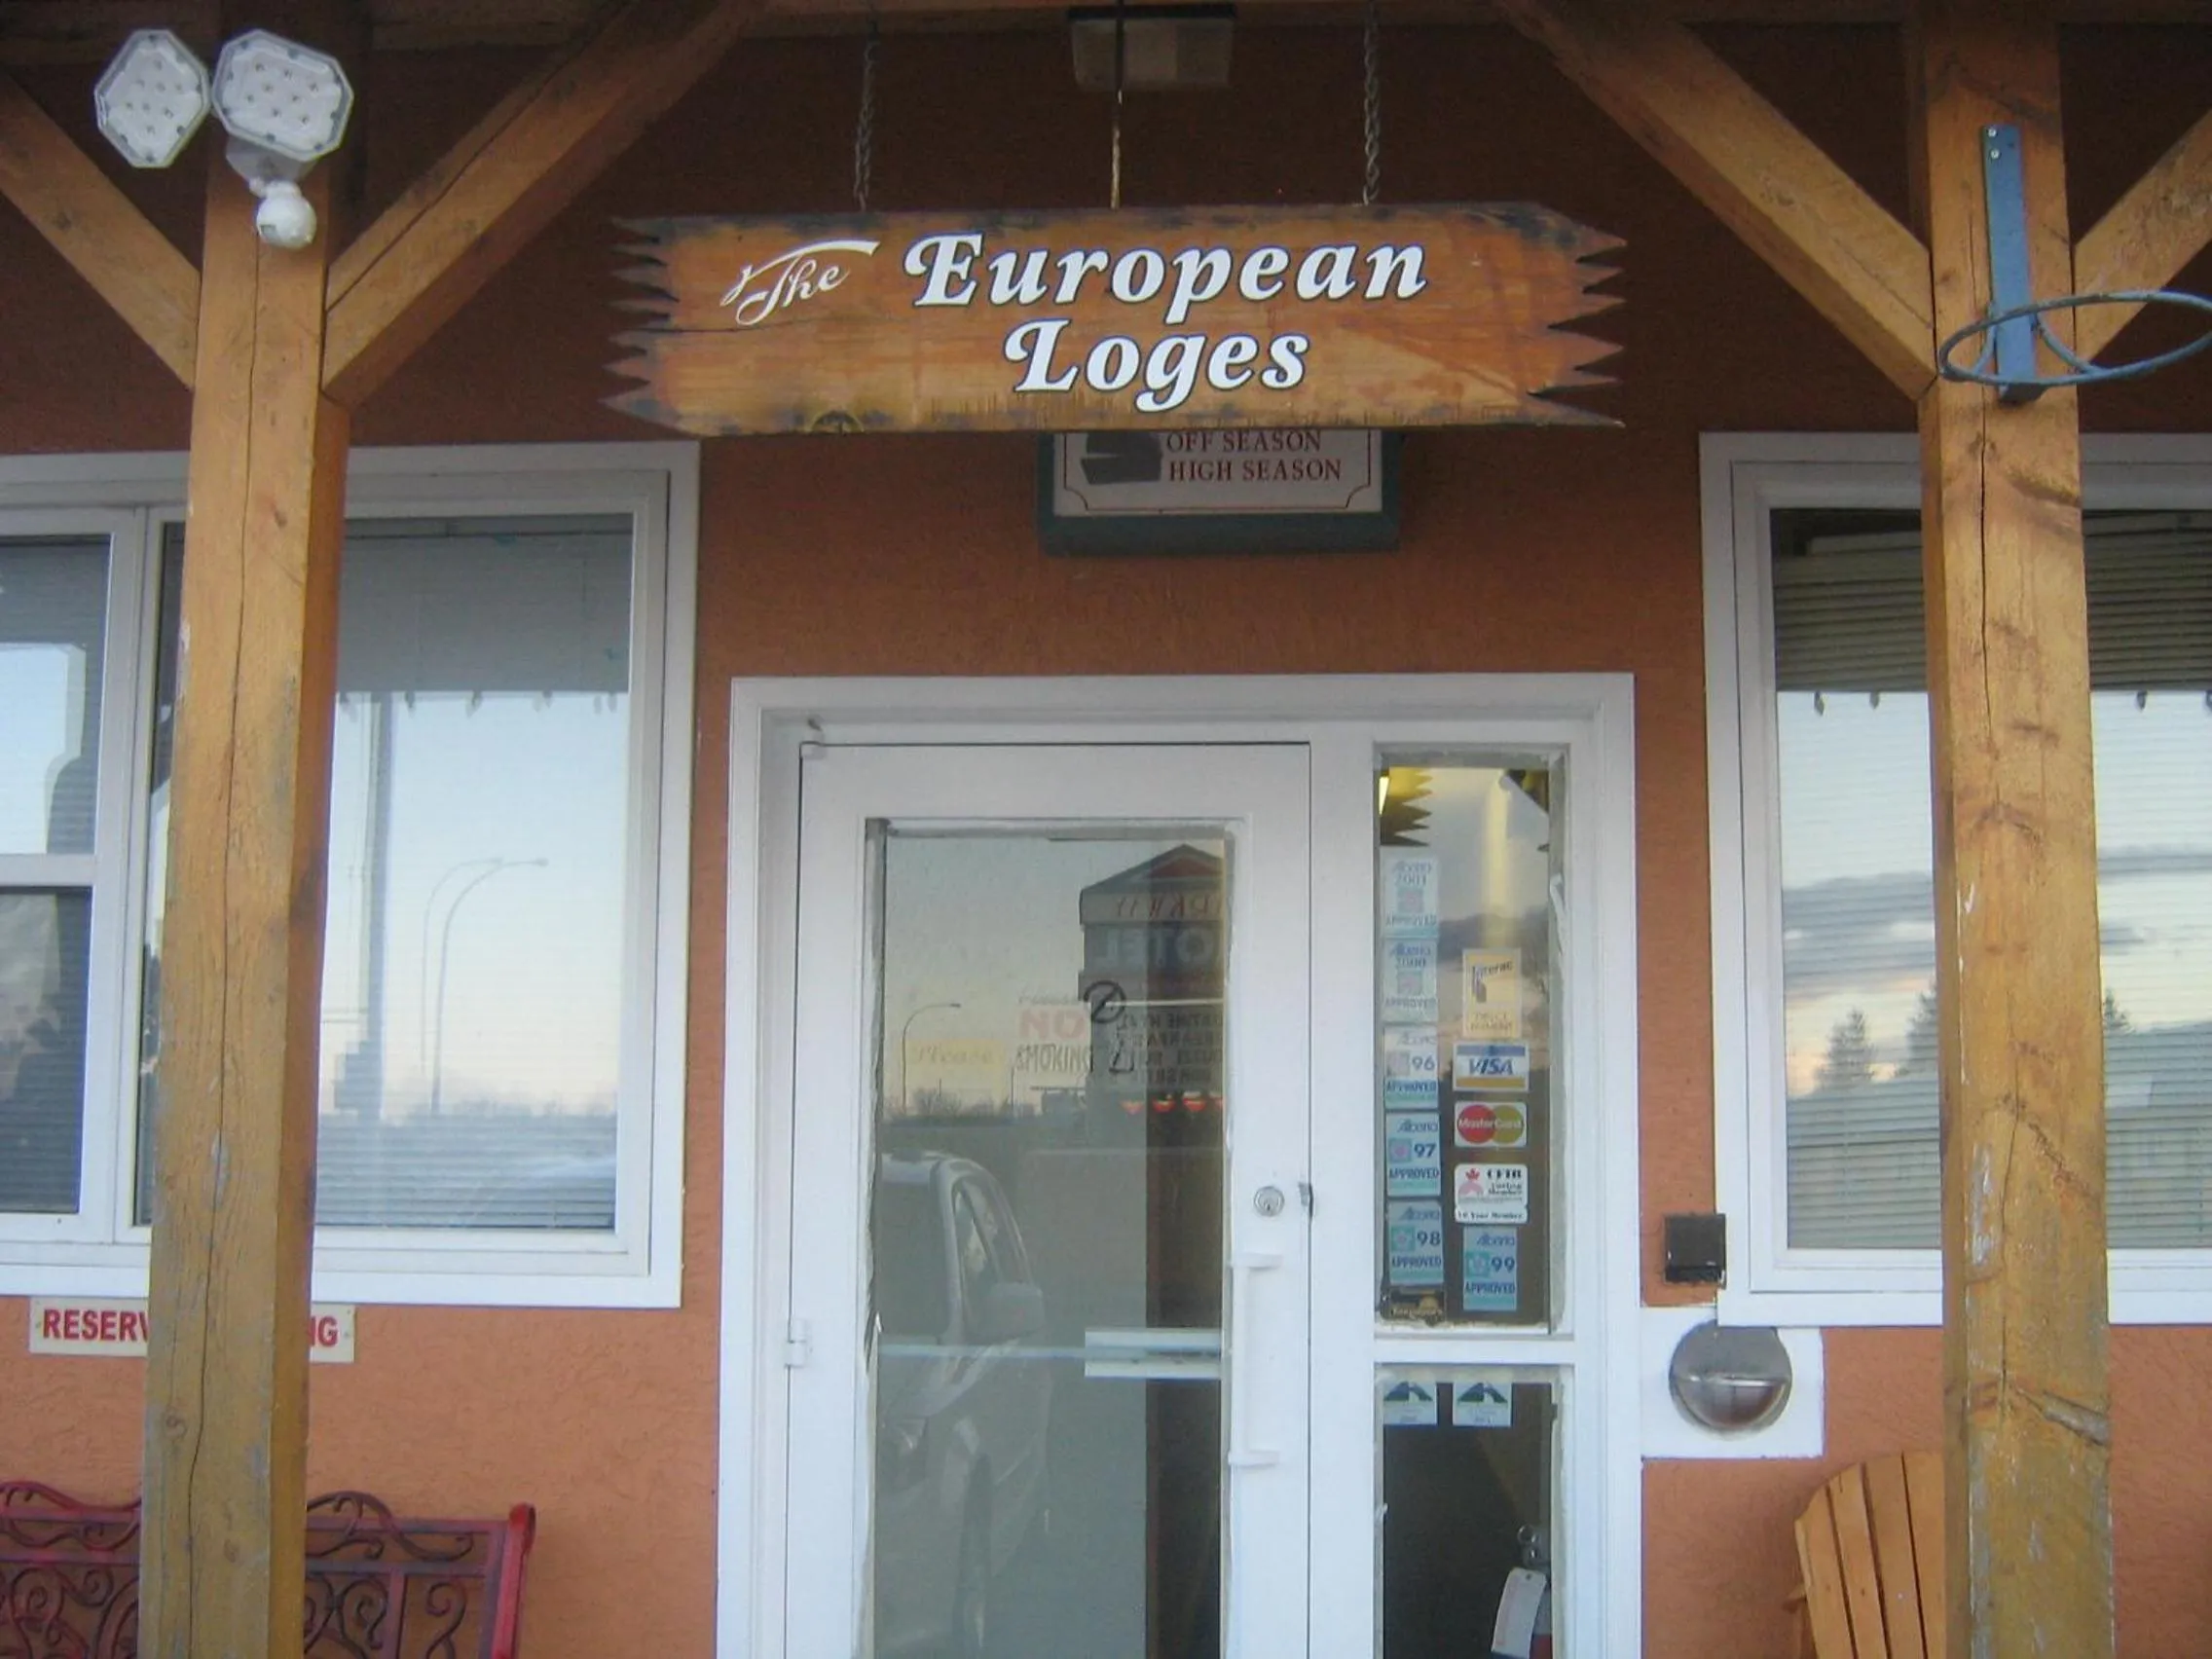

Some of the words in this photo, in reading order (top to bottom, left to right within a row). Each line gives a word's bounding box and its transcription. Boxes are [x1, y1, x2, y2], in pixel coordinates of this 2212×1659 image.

[720, 240, 880, 326] The
[903, 233, 1427, 324] European
[1002, 318, 1310, 413] Loges
[1166, 431, 1214, 453] OFF
[1223, 430, 1322, 453] SEASON
[1169, 461, 1233, 482] HIGH
[1241, 459, 1342, 481] SEASON
[1019, 1009, 1086, 1040] NO
[1412, 1054, 1435, 1071] 96
[1469, 1057, 1514, 1076] VISA
[1414, 1143, 1437, 1158] 97
[1417, 1230, 1441, 1245] 98
[1492, 1256, 1515, 1273] 99
